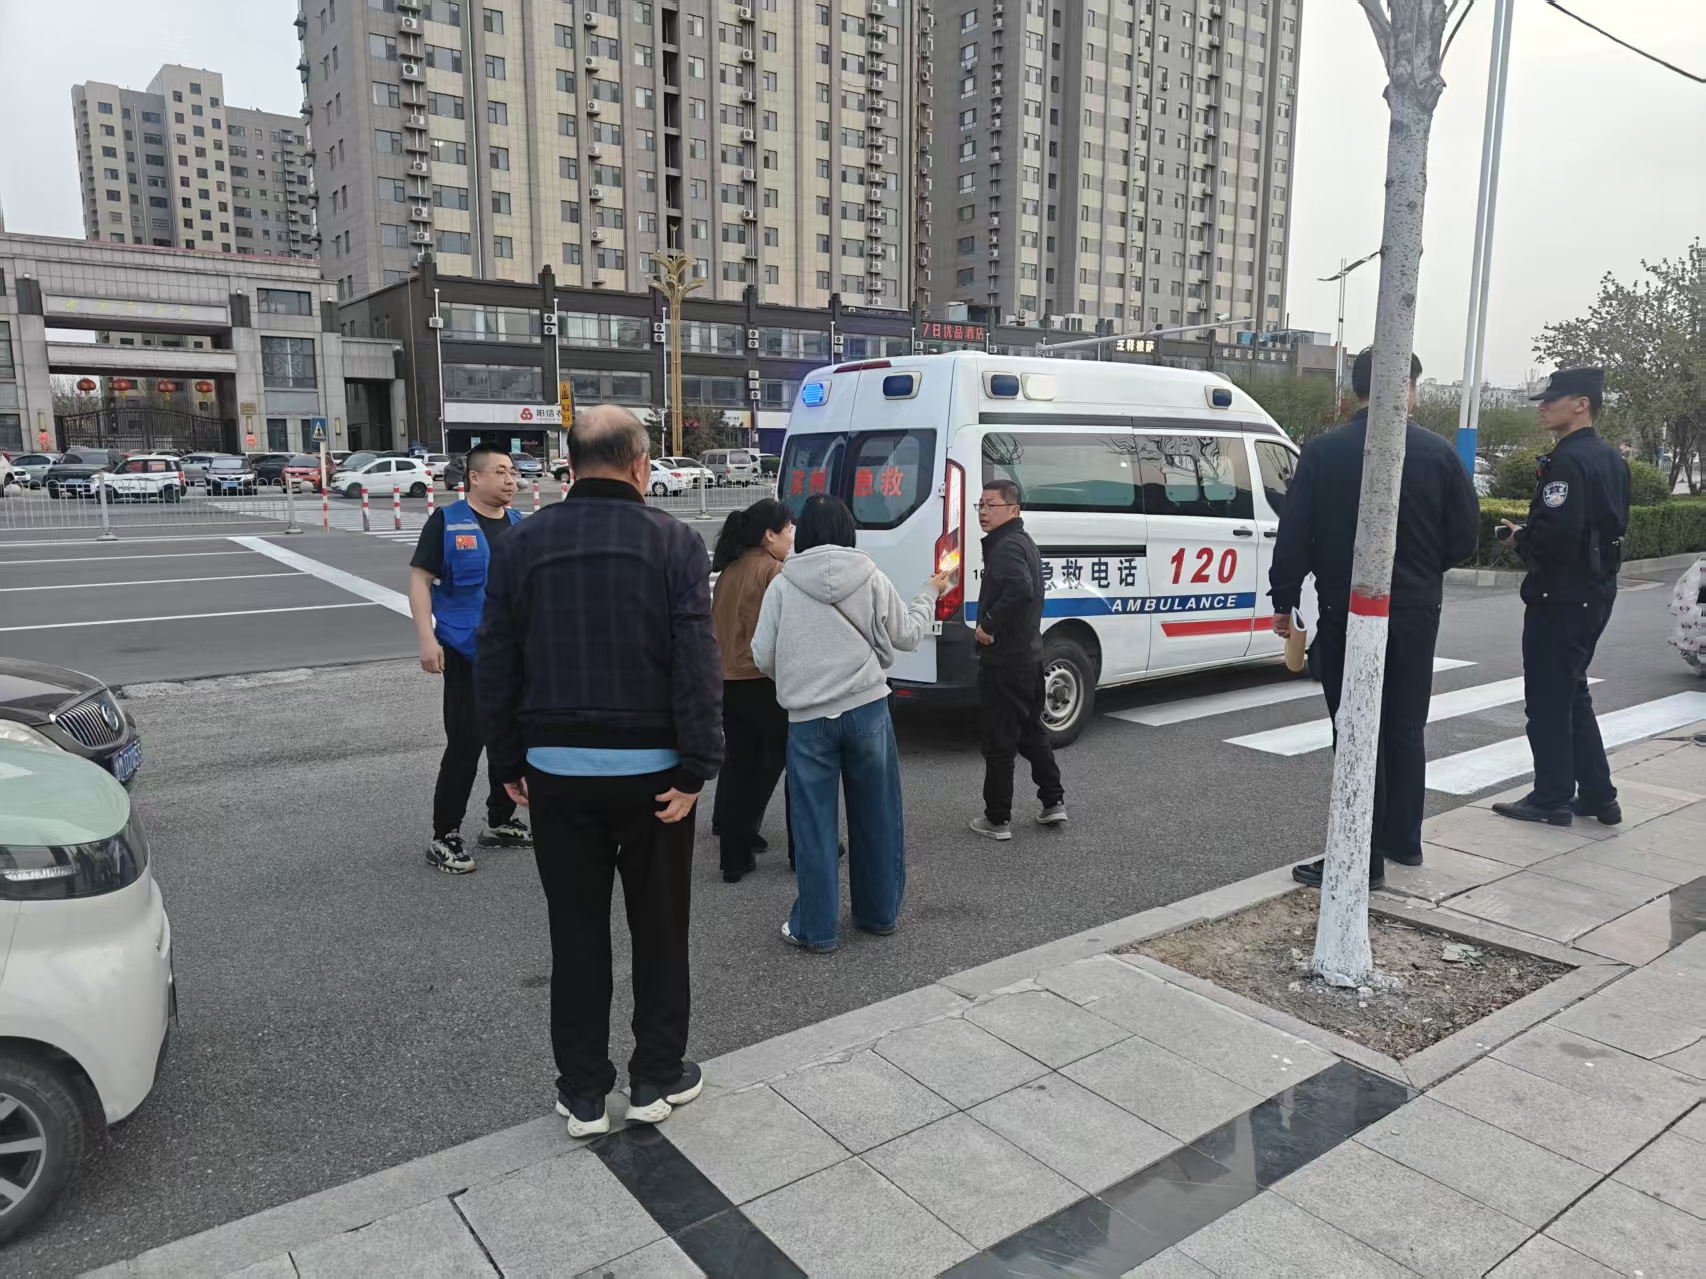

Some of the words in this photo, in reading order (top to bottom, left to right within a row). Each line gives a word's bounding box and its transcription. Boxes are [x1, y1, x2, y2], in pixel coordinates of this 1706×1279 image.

[853, 466, 904, 496] 急救
[1170, 547, 1238, 585] 120
[1111, 594, 1238, 614] AMBULANCE
